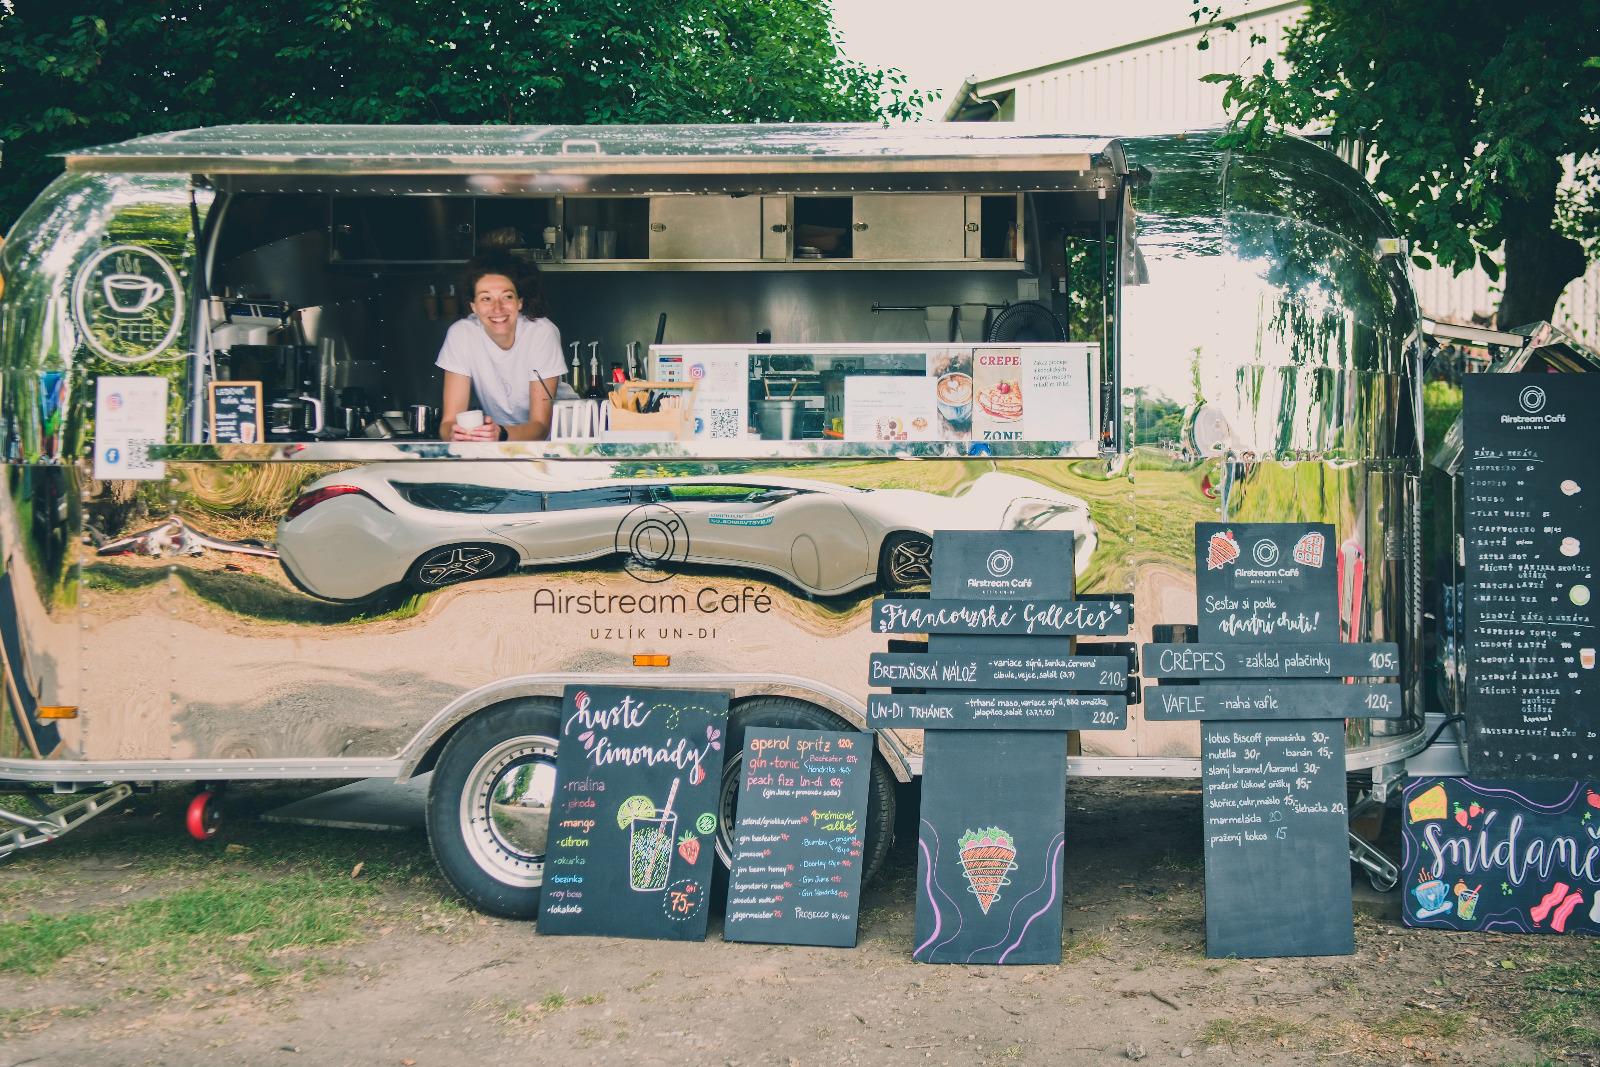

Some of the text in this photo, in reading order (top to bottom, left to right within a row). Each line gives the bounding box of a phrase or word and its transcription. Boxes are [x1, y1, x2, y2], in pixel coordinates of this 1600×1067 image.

[980, 356, 1021, 366] CREPE
[1500, 414, 1566, 423] Airstream Café
[1235, 568, 1299, 577] Airstream Café
[967, 578, 1032, 587] Airstream Café
[533, 586, 772, 614] Airstream Café
[1205, 595, 1276, 615] Sestav si podle
[1219, 611, 1320, 636] vlastní chuti!
[590, 626, 717, 639] UZLÍK UN-DI
[1480, 627, 1525, 636] ESPRESSO
[1159, 649, 1225, 672] CRÊPES
[1284, 653, 1330, 673] palačinky
[1369, 653, 1397, 671] 105,-
[873, 660, 938, 680] BRETAŇSKÁ
[943, 661, 977, 682] NÁLOŽ
[1099, 671, 1126, 687] 210,-
[1162, 694, 1205, 713] VAFLE
[1254, 695, 1279, 709] vafle
[1365, 694, 1392, 712] 120,-
[565, 695, 651, 735] husté
[909, 704, 954, 719] TRHÁNEK
[1092, 711, 1119, 725] 220,-
[1208, 733, 1230, 744] lotus
[1233, 732, 1262, 743] Biscoff
[1312, 732, 1329, 744] 30,-
[751, 736, 790, 757] aperol
[797, 736, 831, 759] spritz
[1209, 748, 1236, 759] nutella
[1285, 748, 1312, 757] banán
[587, 736, 711, 784] limonády
[749, 757, 767, 775] gin
[1208, 764, 1230, 778] slaný
[1303, 763, 1320, 775] 30,-
[568, 777, 605, 791] malina
[747, 774, 773, 791] peach
[778, 773, 794, 786] fizz
[1209, 780, 1238, 794] pražené
[1295, 803, 1328, 814] šlehačka
[1209, 814, 1262, 824] marmeláda
[563, 820, 595, 833] mango
[560, 836, 588, 848] citron
[1210, 832, 1241, 848] pražený
[1244, 830, 1267, 841] kokos
[557, 856, 585, 865] okurka
[671, 892, 695, 914] 75,-
